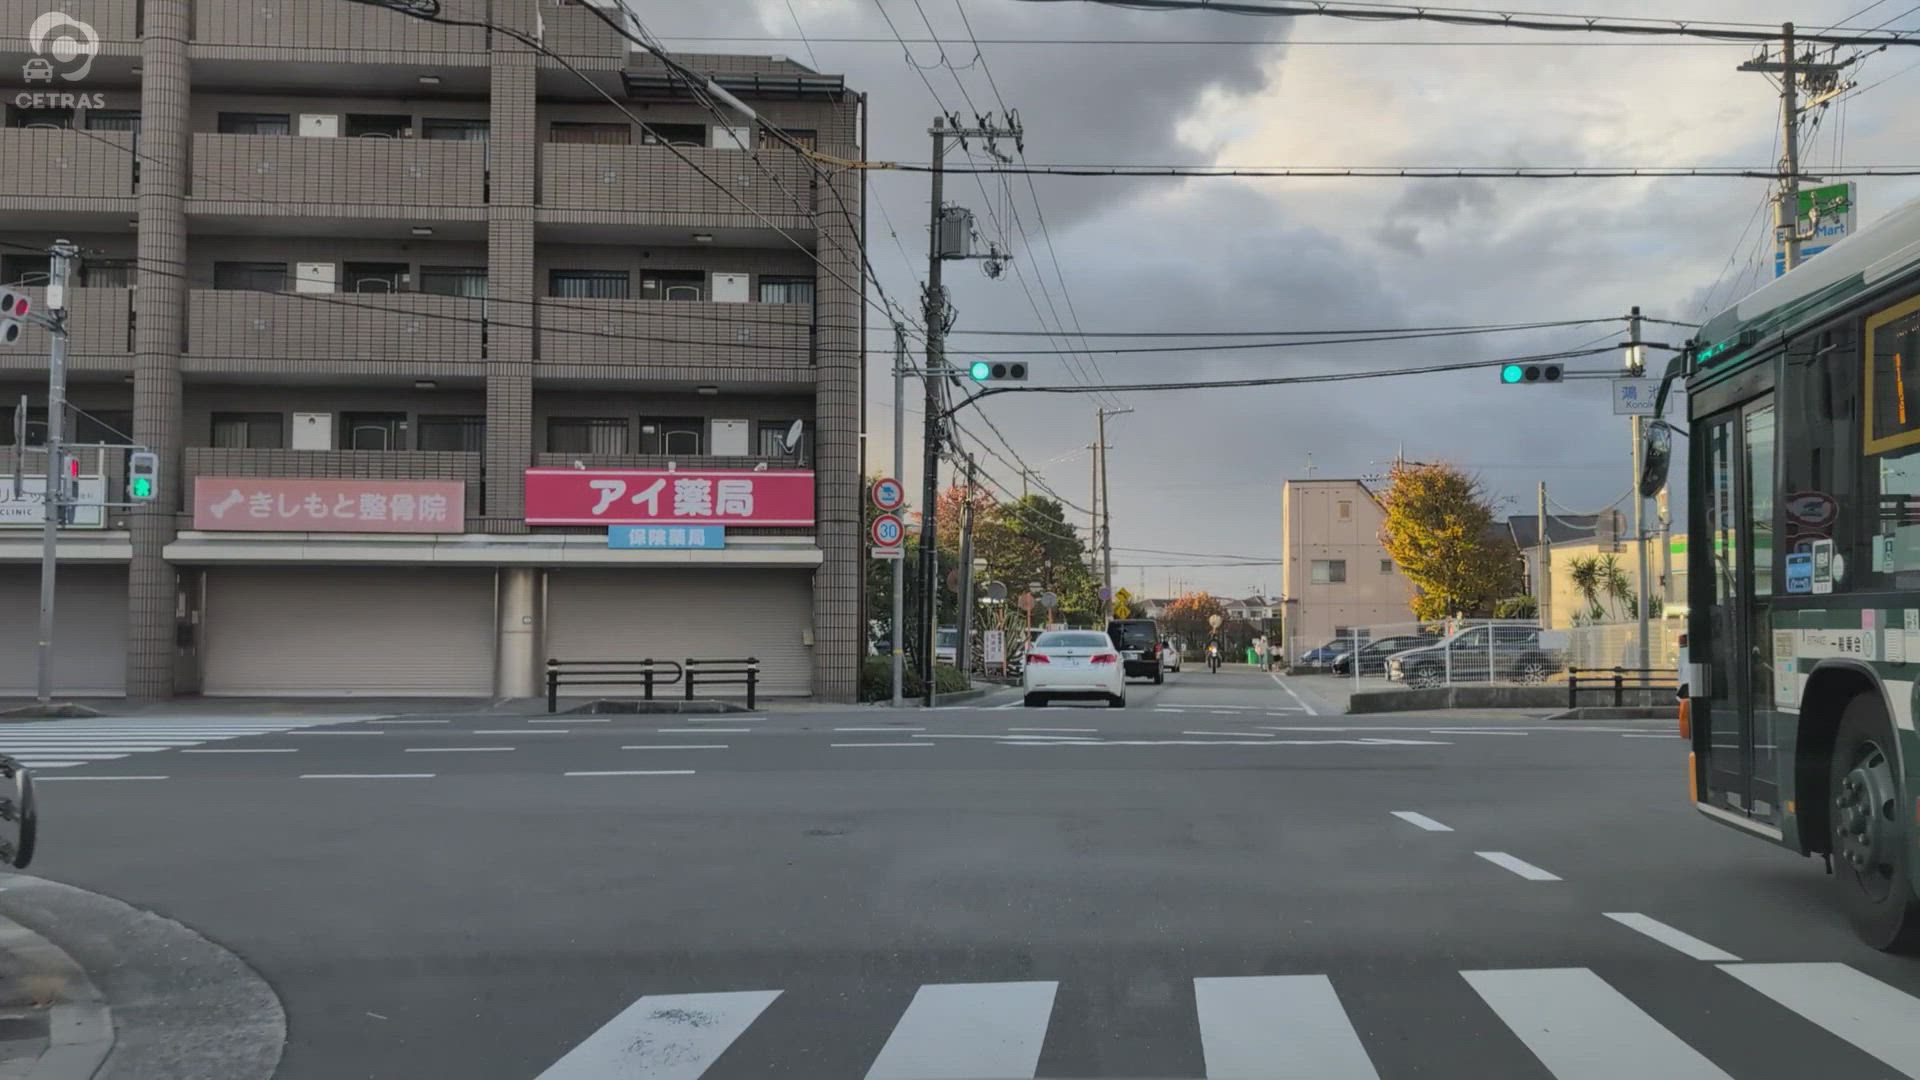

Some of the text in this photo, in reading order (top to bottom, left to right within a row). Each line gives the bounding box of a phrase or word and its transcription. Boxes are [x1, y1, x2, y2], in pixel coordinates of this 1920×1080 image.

[249, 488, 448, 521] きしもと整骨院
[589, 478, 754, 516] アイ薬局
[0, 508, 33, 516] CLINIC
[628, 528, 706, 546] 保険薬局
[880, 524, 897, 538] 30
